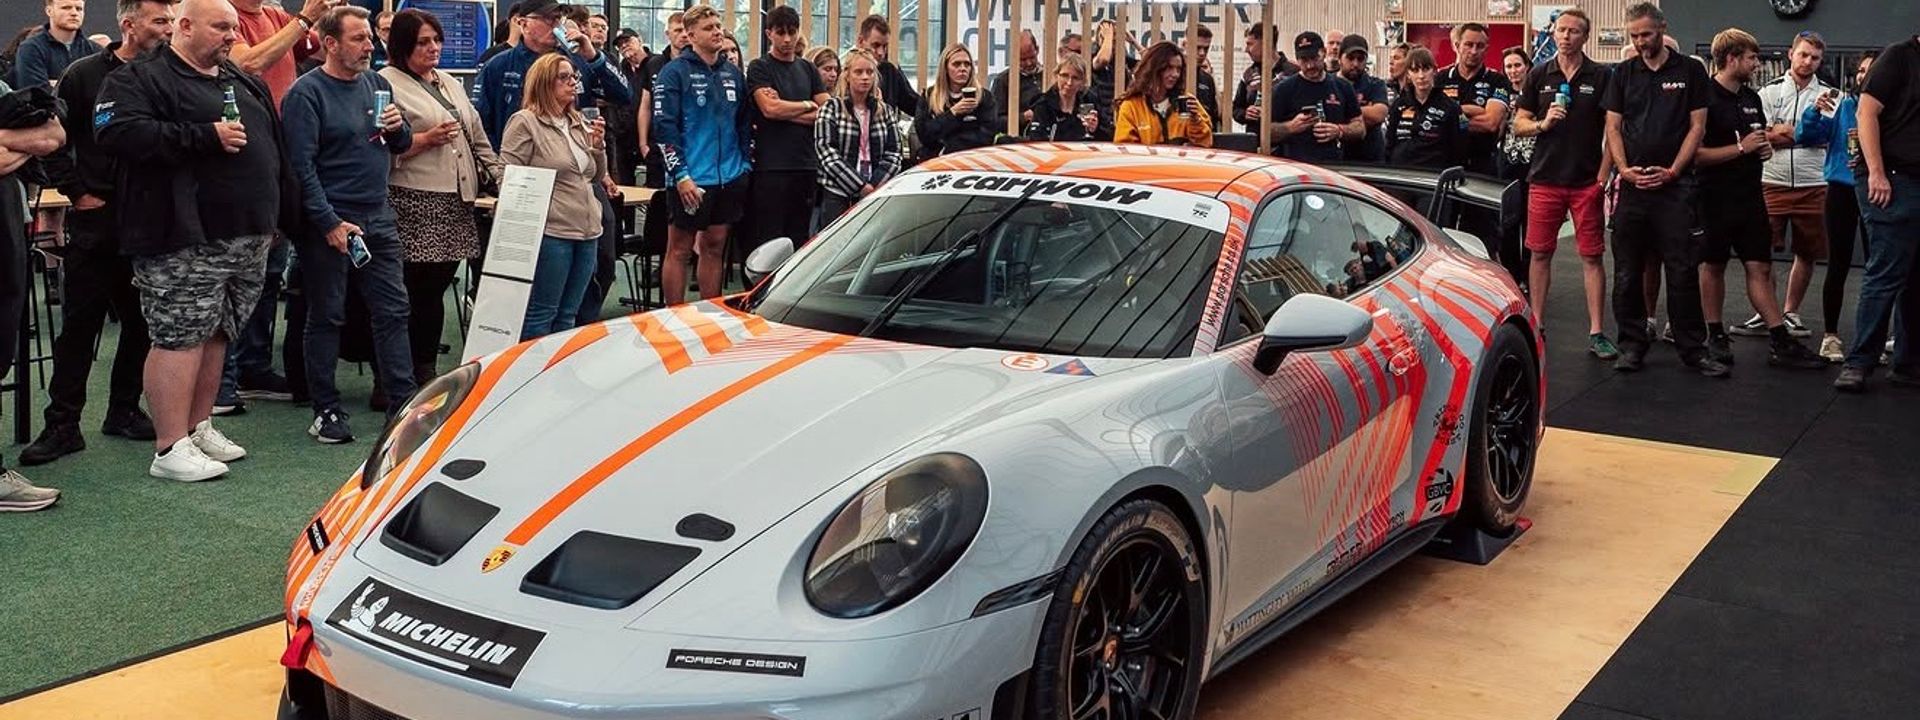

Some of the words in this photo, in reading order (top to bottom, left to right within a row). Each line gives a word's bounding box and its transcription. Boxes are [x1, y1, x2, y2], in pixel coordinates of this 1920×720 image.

[952, 175, 1153, 205] carwow
[1207, 237, 1241, 327] www.porsche.co.uk
[378, 611, 516, 665] MICHELIN
[675, 655, 742, 666] PORSCHE
[745, 659, 798, 670] DESIGN
